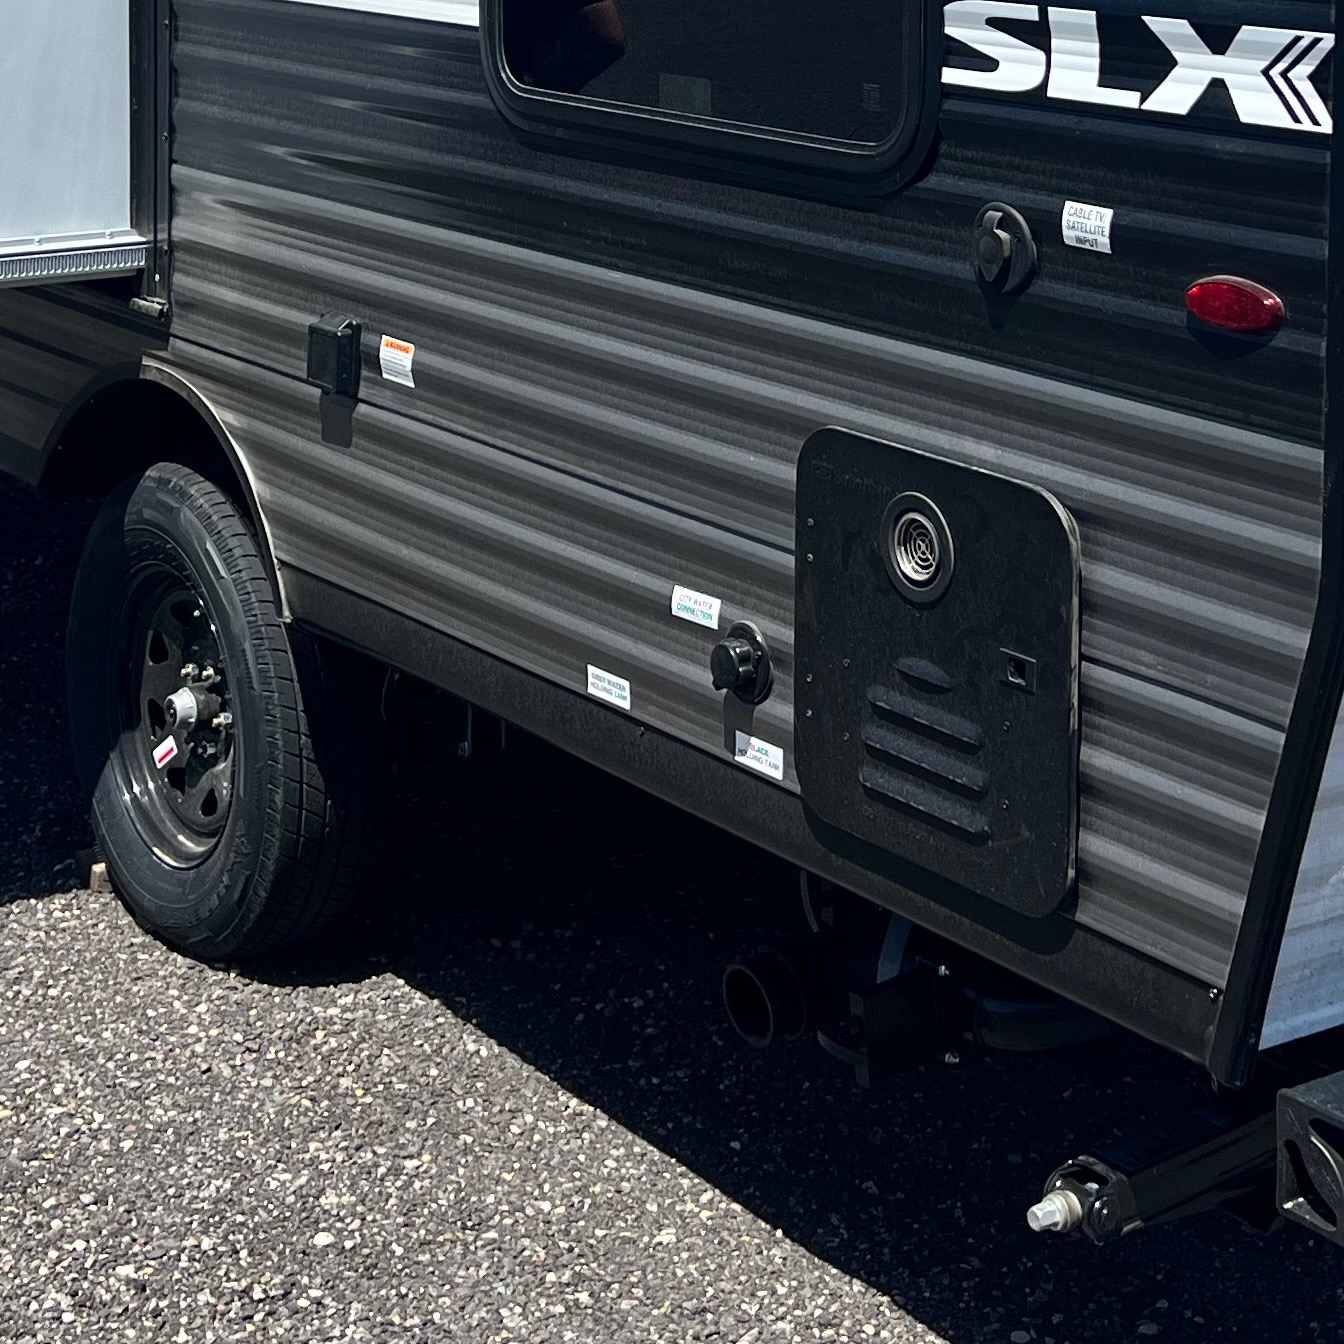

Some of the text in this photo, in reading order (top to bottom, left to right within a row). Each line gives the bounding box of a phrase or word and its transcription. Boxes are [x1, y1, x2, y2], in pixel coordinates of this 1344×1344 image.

[941, 0, 1336, 135] SLX
[1068, 206, 1093, 221] CABLE
[1066, 219, 1106, 237] SATELLITE
[1075, 235, 1098, 249] INPUT
